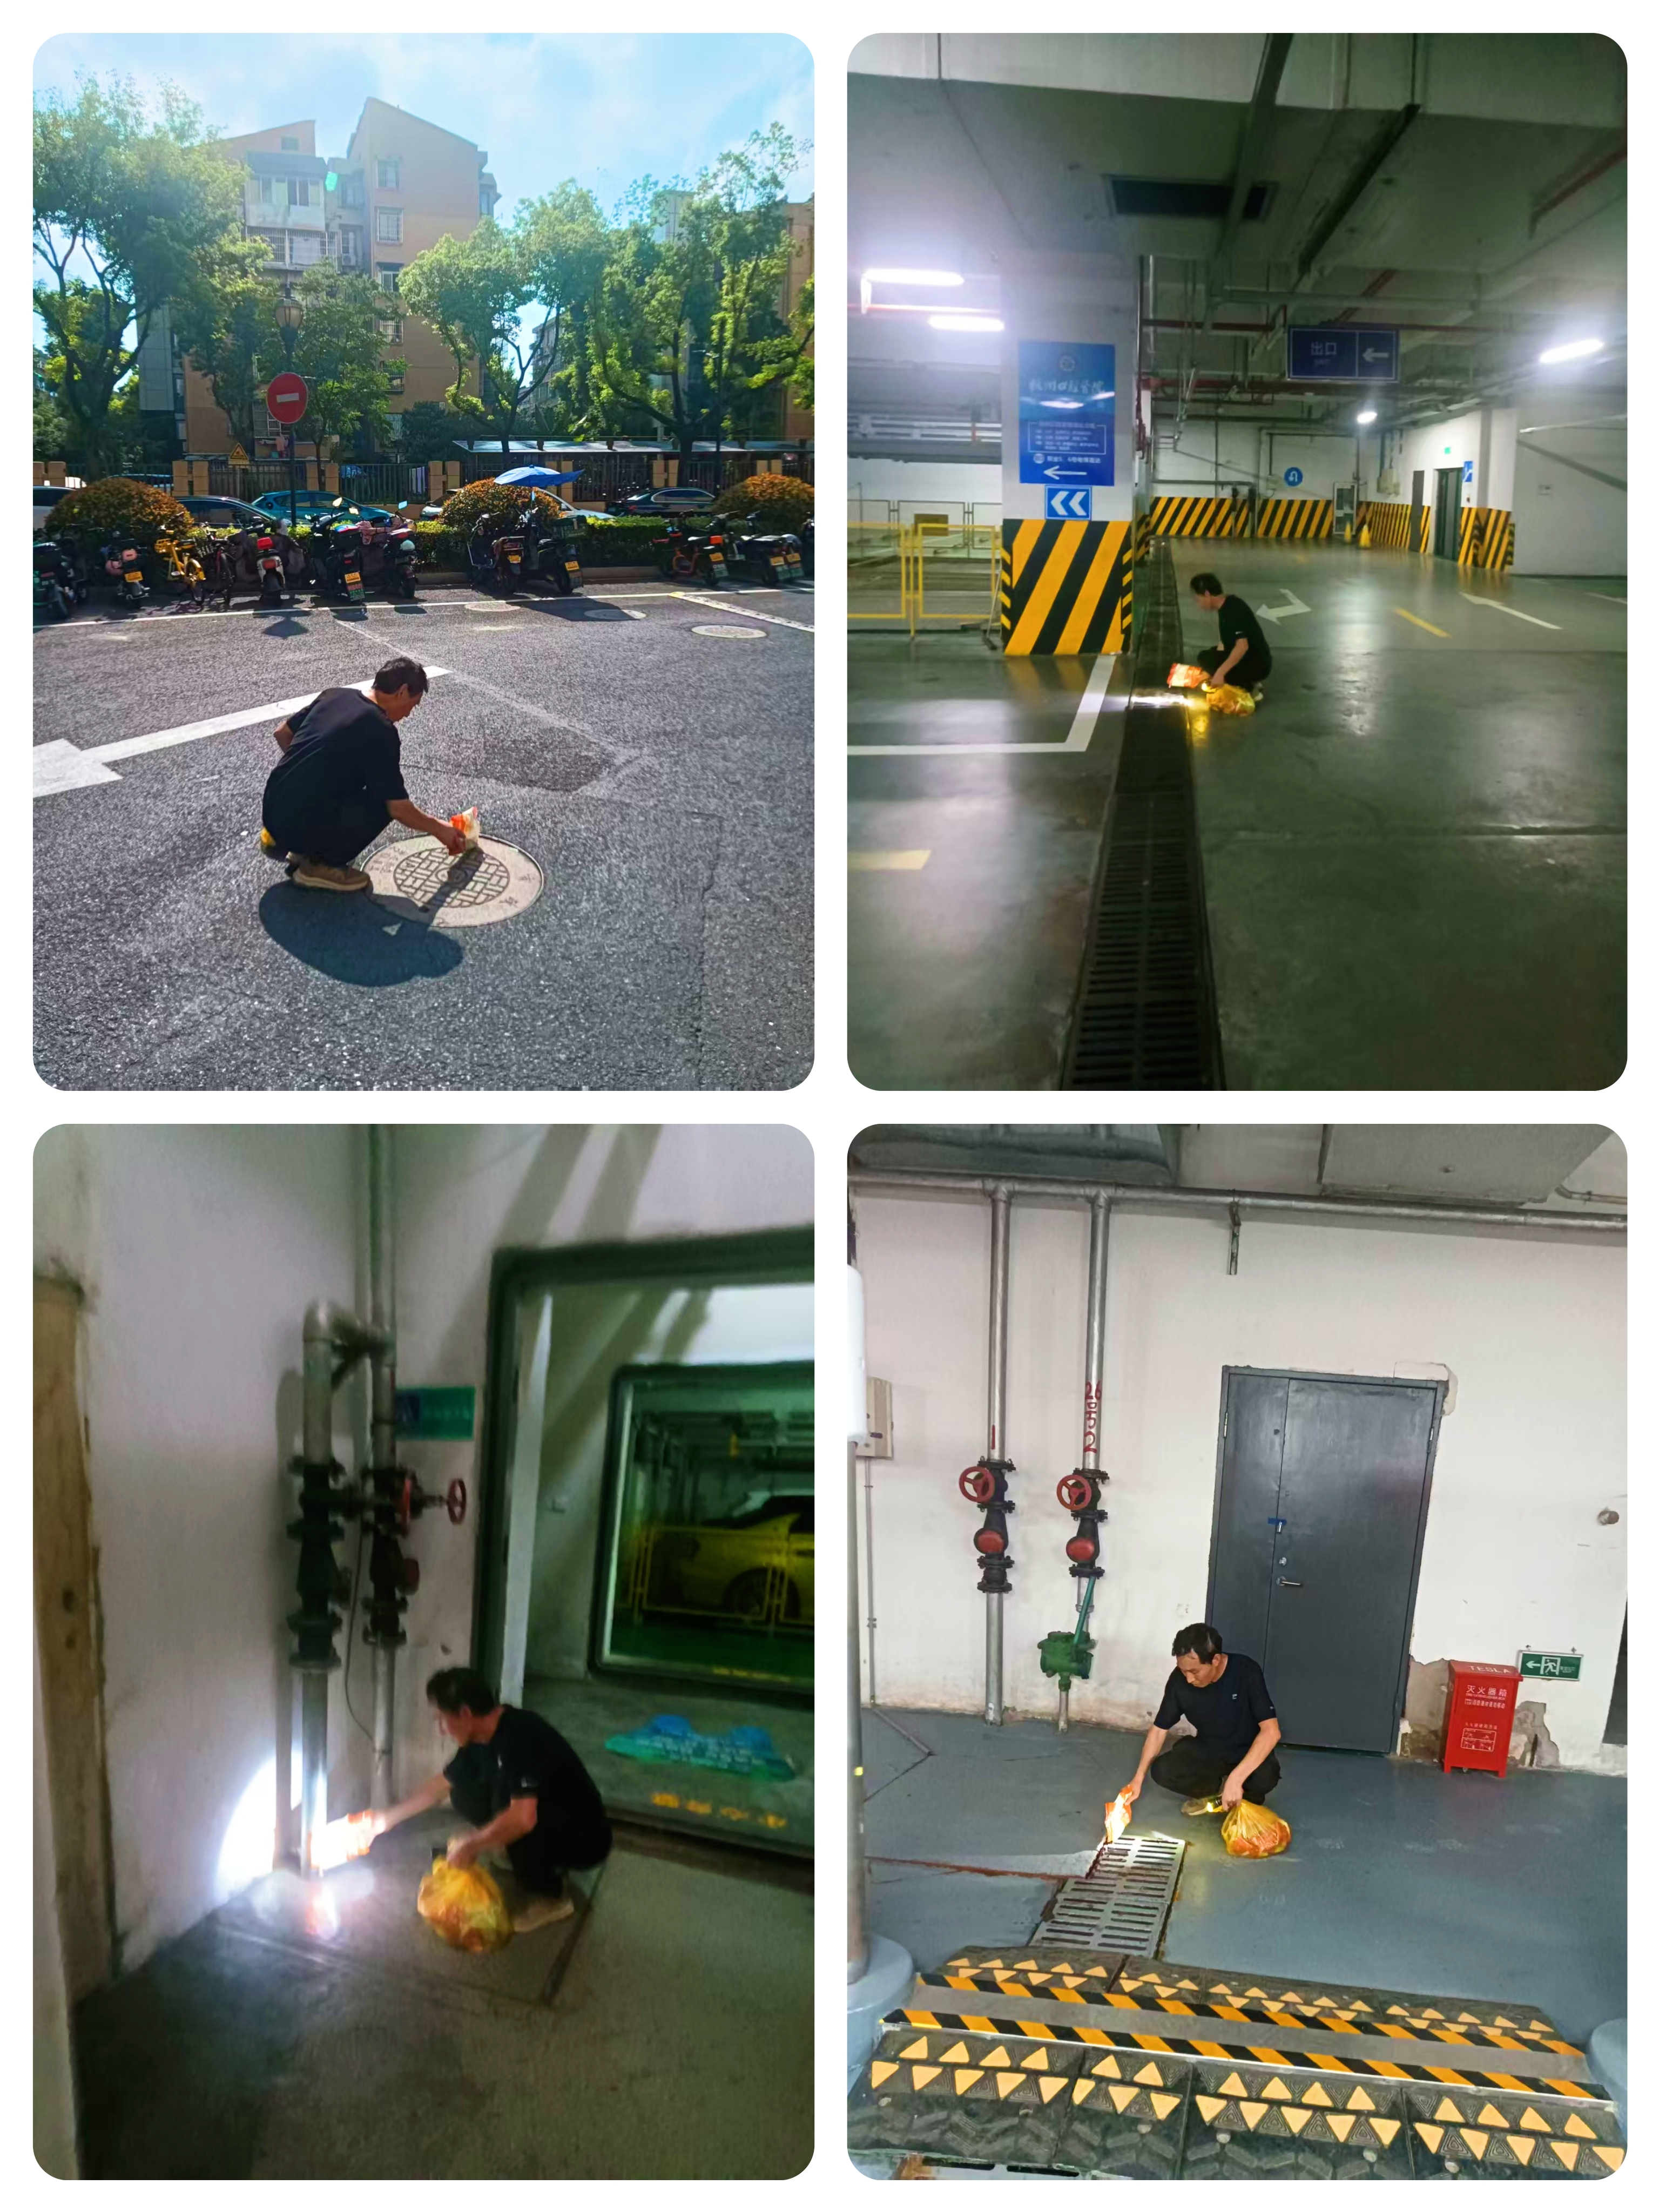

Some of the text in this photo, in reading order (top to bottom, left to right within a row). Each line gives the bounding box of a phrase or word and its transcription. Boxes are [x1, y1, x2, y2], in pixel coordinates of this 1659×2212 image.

[1311, 341, 1337, 355] 出口
[1466, 1685, 1507, 1697] 灭火器箱
